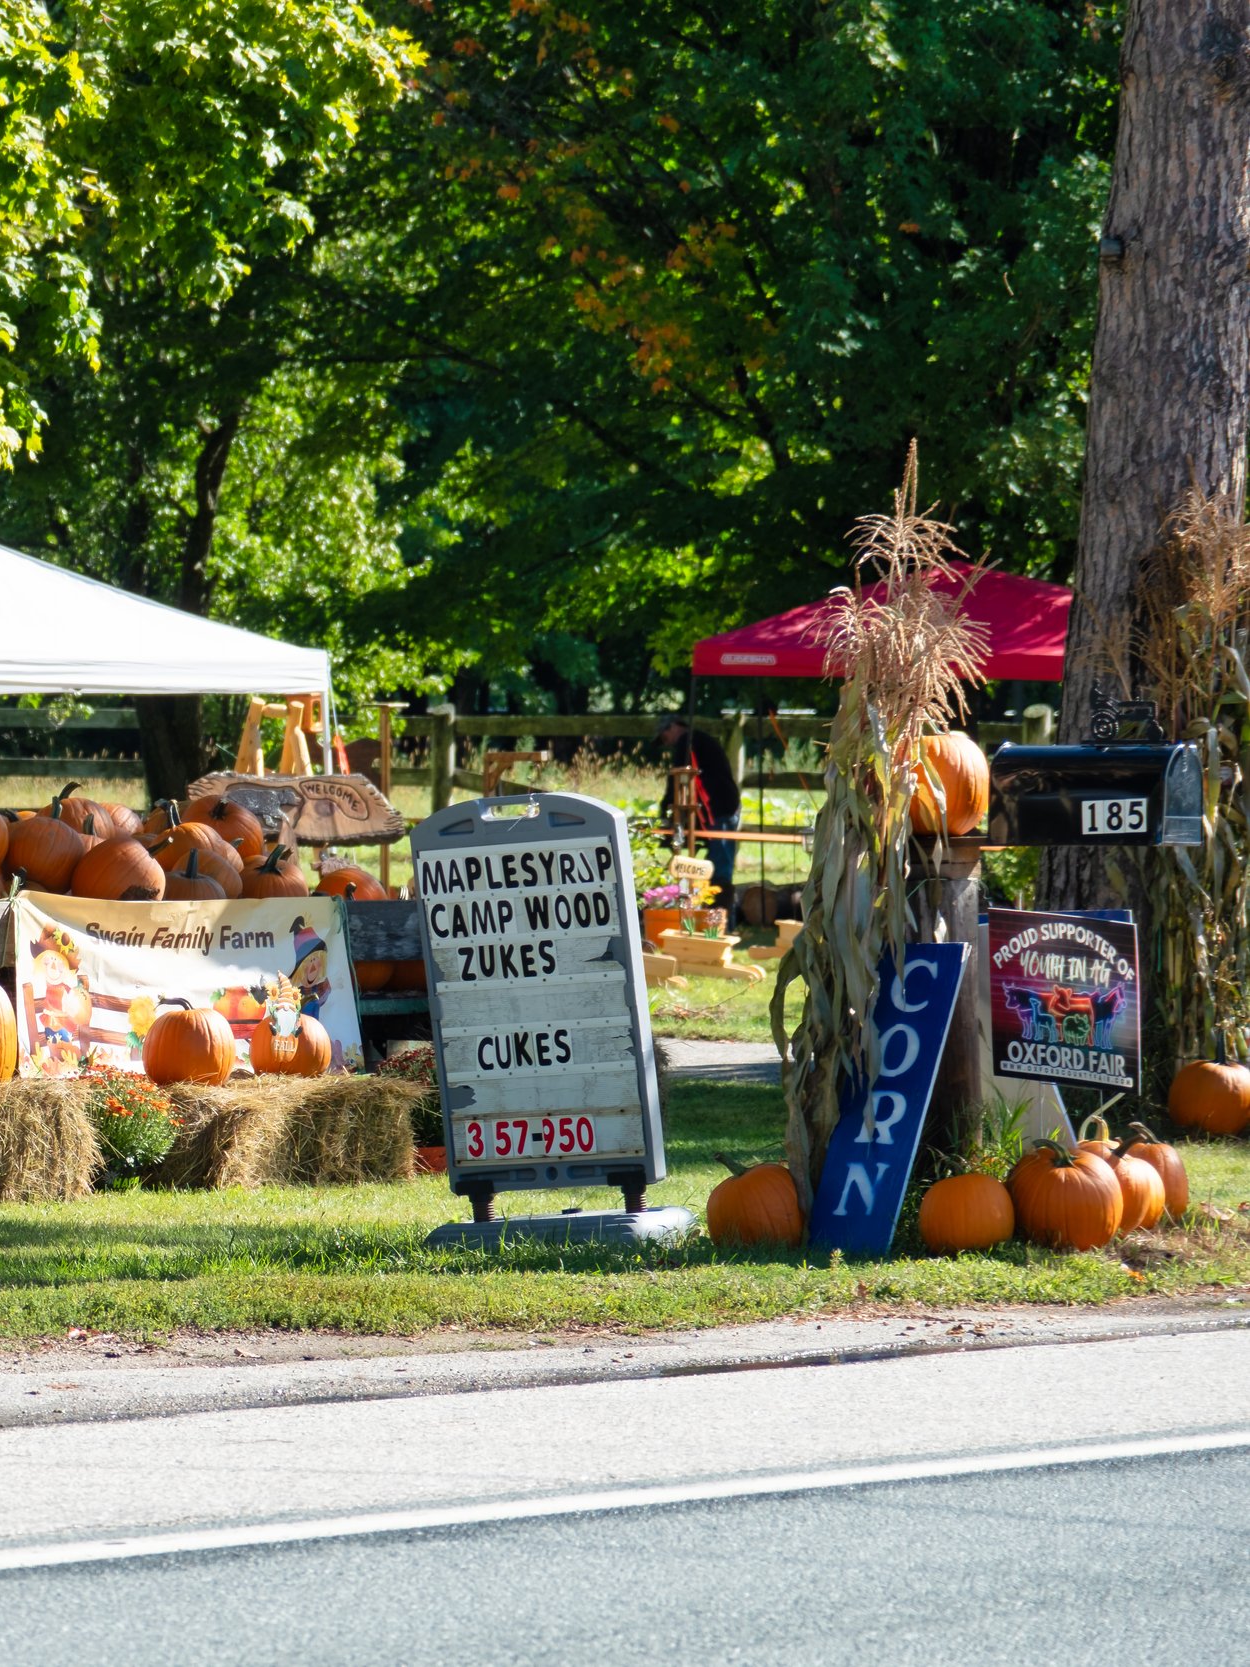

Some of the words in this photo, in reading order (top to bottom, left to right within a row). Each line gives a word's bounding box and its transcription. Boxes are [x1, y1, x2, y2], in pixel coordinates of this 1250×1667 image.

[303, 782, 360, 812] WELCOME
[1087, 800, 1144, 832] 185
[430, 899, 514, 939] CAMP
[524, 891, 611, 931] WOOD
[85, 922, 145, 949] Swain
[150, 926, 214, 957] Family
[219, 925, 275, 950] Farm
[992, 927, 1039, 969] PROUD
[1040, 922, 1117, 965] SUPPORTER
[1117, 958, 1136, 981] OF
[457, 939, 556, 982] ZUKES
[1019, 949, 1065, 983] YOUTH
[1067, 956, 1087, 983] IN
[1090, 958, 1112, 988] AG
[274, 1039, 297, 1052] FALL
[477, 1028, 572, 1071] CUKES
[1007, 1040, 1085, 1071] OXFORD
[1089, 1050, 1127, 1077] FAIR
[832, 958, 938, 1216] CORN
